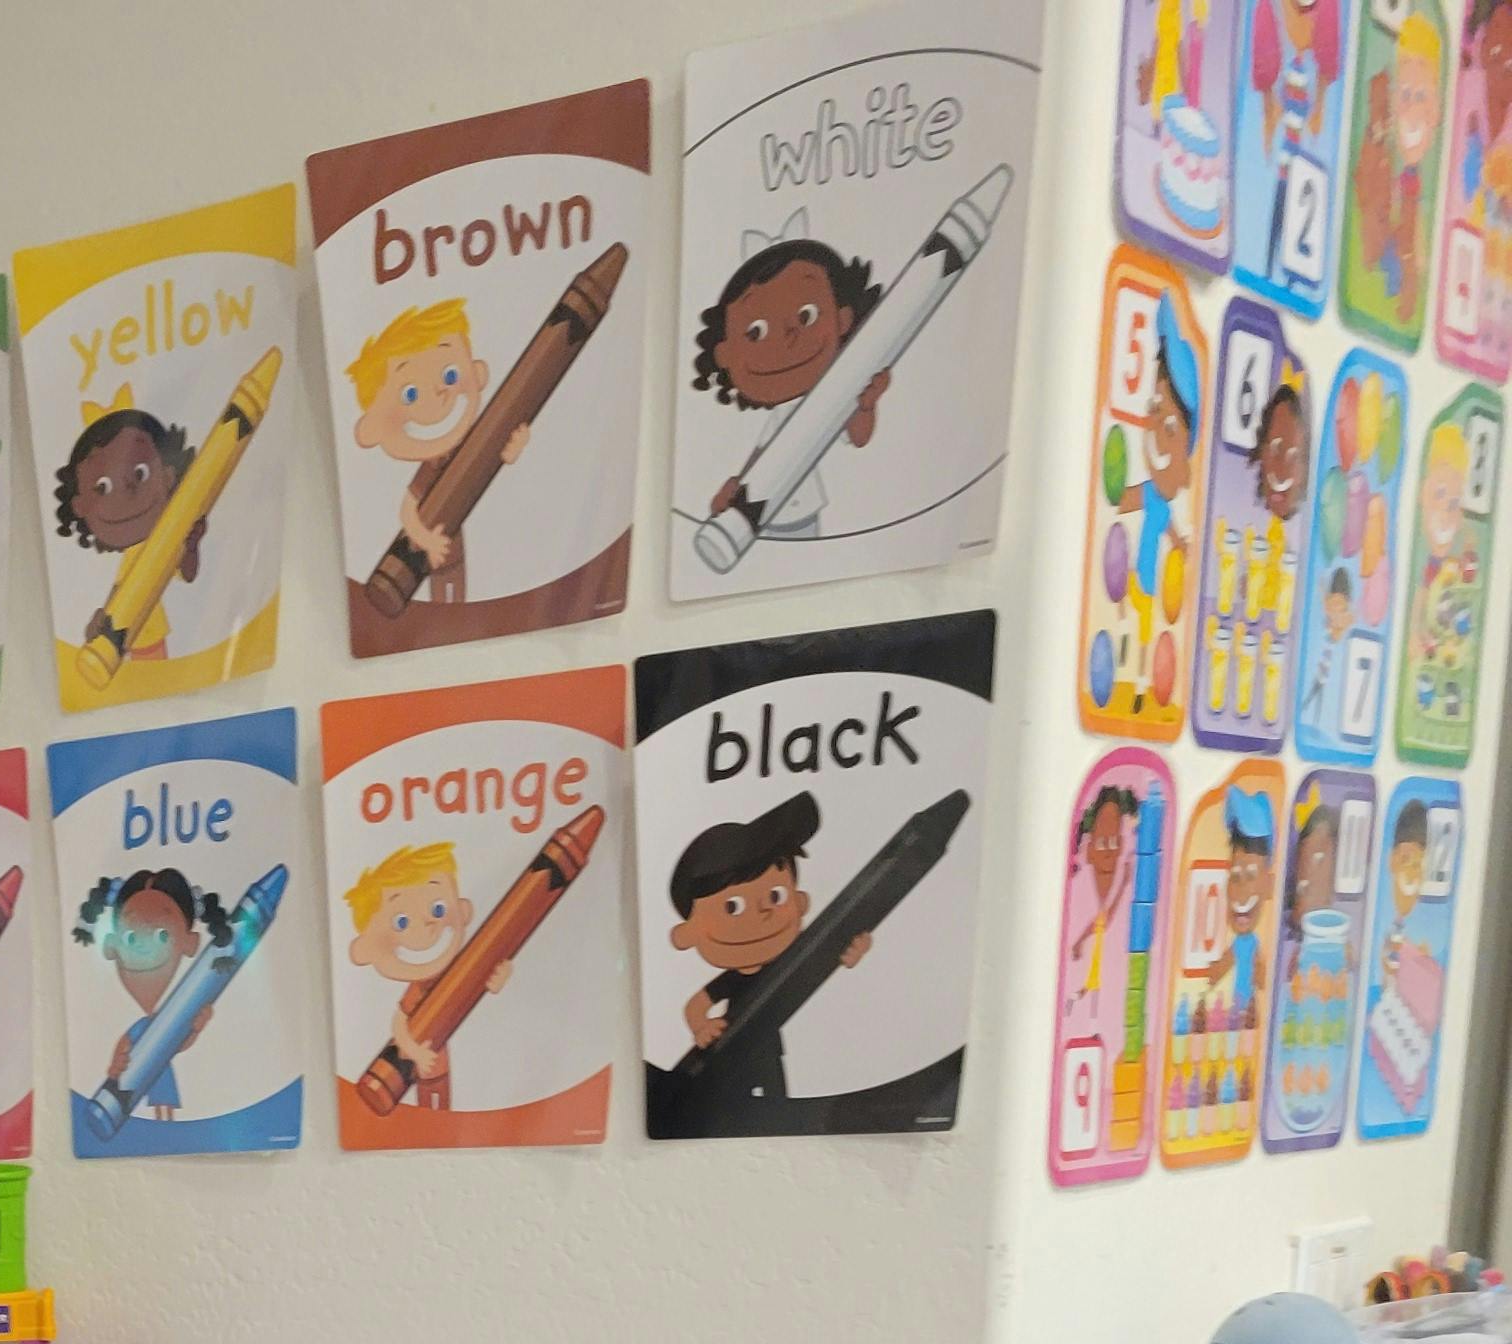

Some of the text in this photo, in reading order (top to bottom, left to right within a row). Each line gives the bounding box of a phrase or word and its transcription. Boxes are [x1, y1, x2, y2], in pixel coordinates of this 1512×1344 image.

[761, 82, 963, 191] white
[372, 194, 593, 286] brown
[1296, 178, 1317, 258] 2
[70, 280, 256, 391] yellow
[1123, 311, 1146, 394] 5
[1238, 352, 1259, 429] 6
[1350, 656, 1374, 725] 7
[708, 690, 922, 784] black
[122, 782, 233, 850] blue
[360, 757, 590, 834] orange
[1191, 882, 1221, 952] 10
[1074, 1061, 1092, 1133] 9
